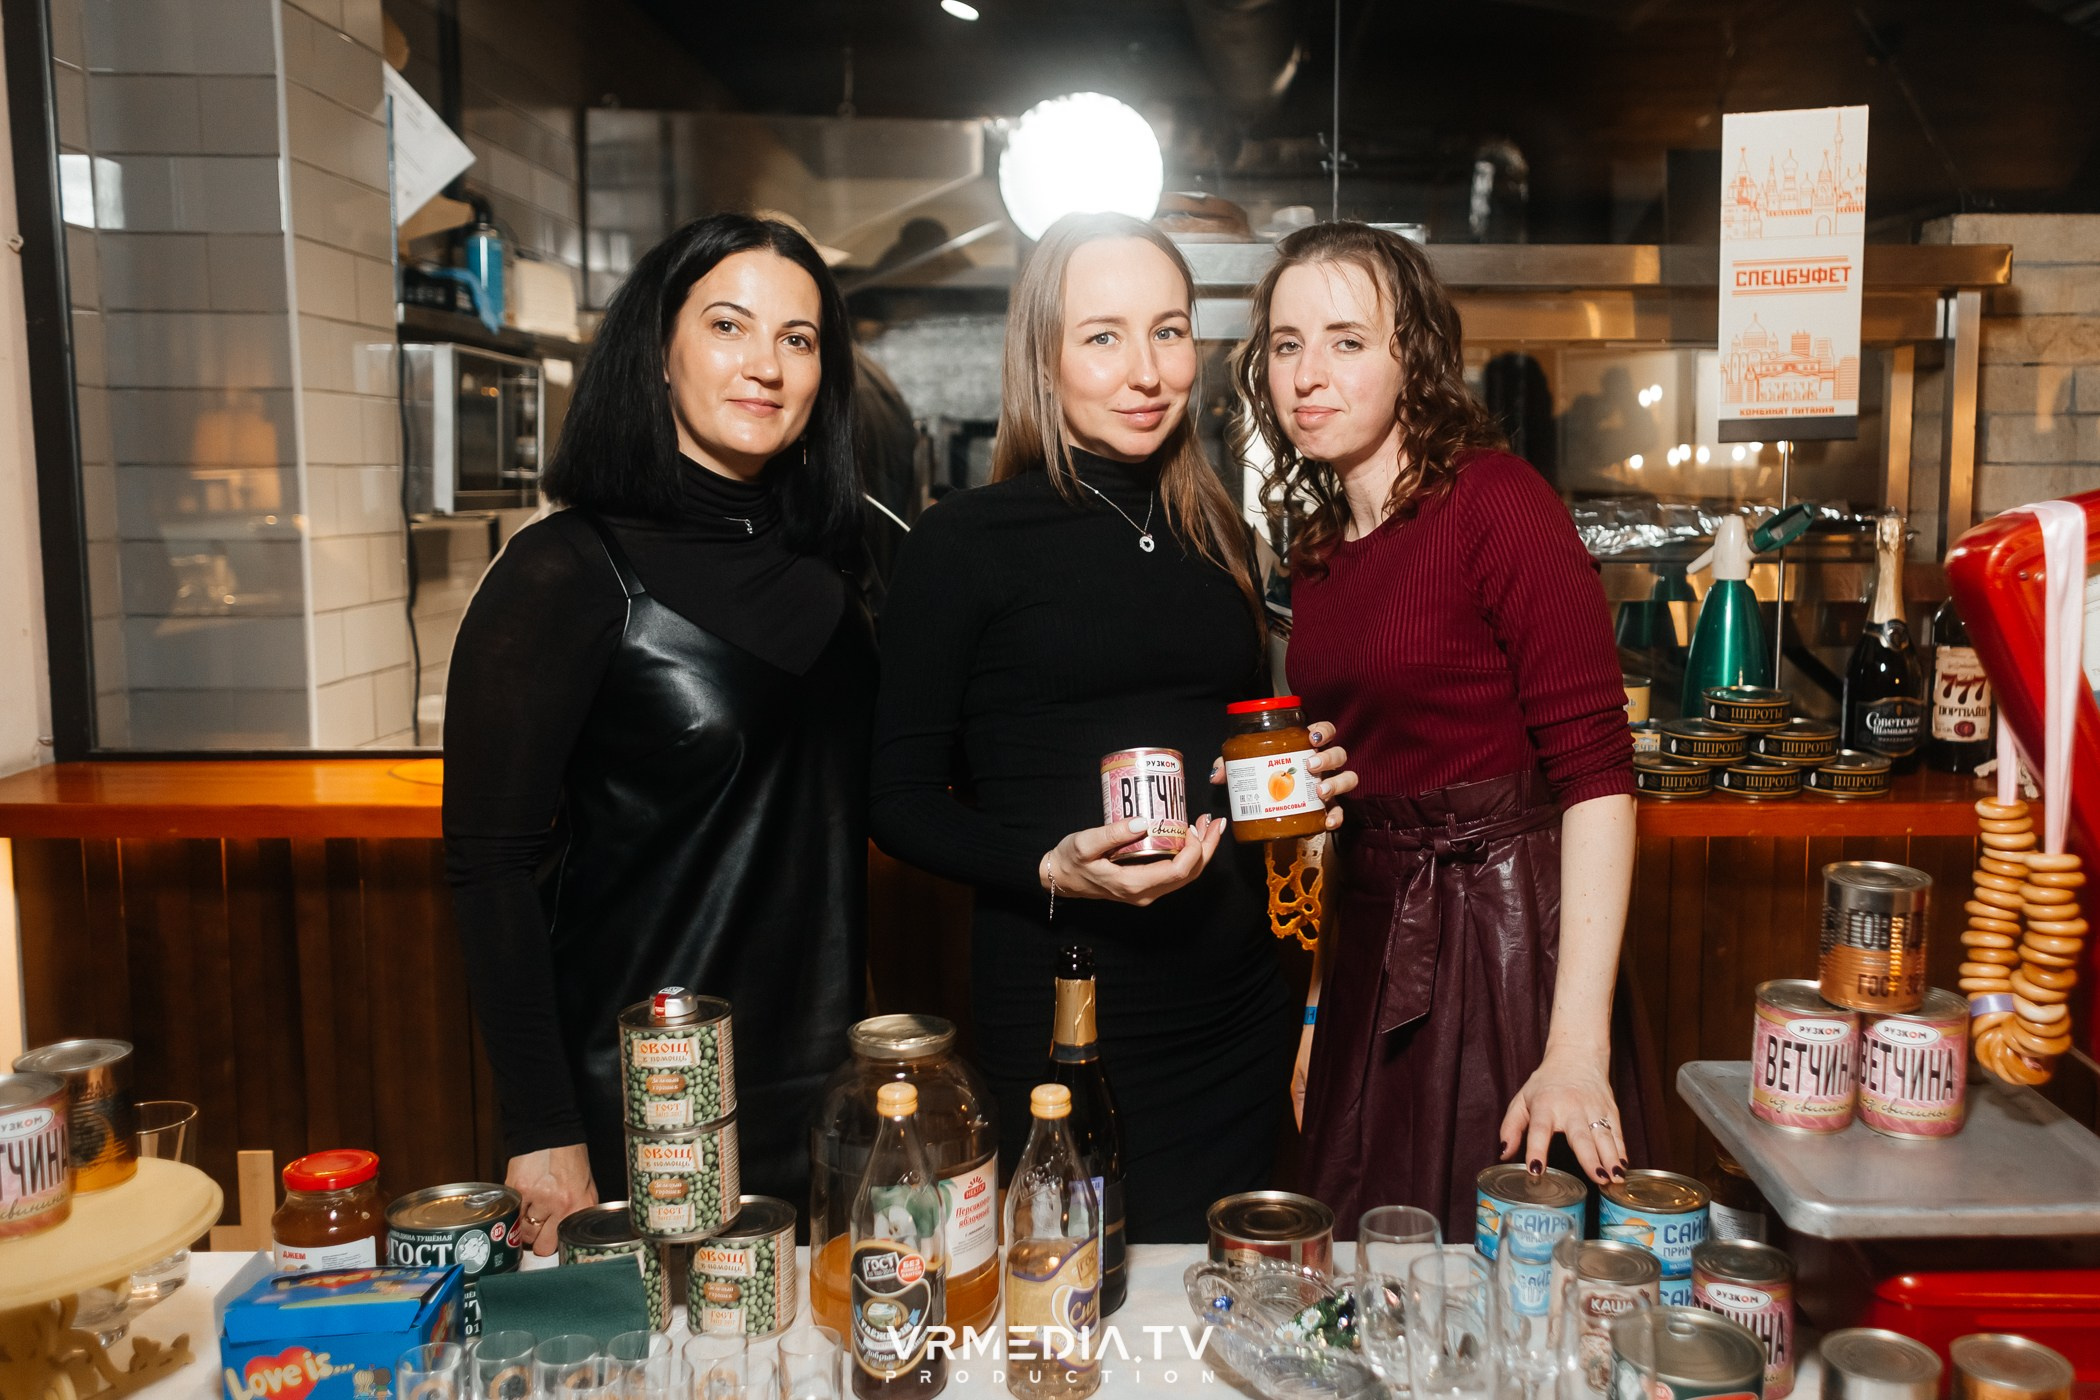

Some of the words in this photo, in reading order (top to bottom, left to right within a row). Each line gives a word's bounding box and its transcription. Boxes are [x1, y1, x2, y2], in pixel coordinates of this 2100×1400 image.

[1735, 266, 1851, 287] СПЕЦБУФЕТ
[1740, 408, 1787, 416] КОМБИНАТ
[1792, 406, 1834, 415] ПИТАНИЯ
[1941, 673, 1988, 704] 777
[1731, 707, 1782, 719] ШПРОТЫ
[1938, 705, 1987, 717] ПОРТВАЙН
[1693, 742, 1743, 754] ШПРОТЫ
[1782, 742, 1832, 753] ШПРОТЫ
[1146, 760, 1176, 768] РУЗКОМ
[1267, 758, 1292, 768] ДЖЕМ
[1661, 776, 1709, 788] ШПРОТЫ
[1746, 776, 1797, 788] ШПРОТЫ
[1833, 776, 1885, 788] ШПРОТЫ
[1121, 775, 1185, 822] ВЕТЧИН
[1264, 801, 1307, 813] АБРИКОСОВЫЙ
[1152, 819, 1187, 834] свинин
[1799, 1026, 1841, 1035] РУЗКОМ
[1884, 1026, 1927, 1040] РУЗКОМ
[640, 1043, 689, 1055] ОВОЩ
[1859, 1034, 1954, 1102] ВЕТЧИНА
[655, 1103, 680, 1111] ГОСТ
[1769, 1096, 1785, 1113] из
[0, 1116, 43, 1132] УЗКОМ
[644, 1148, 692, 1161] ОВОЩ
[658, 1207, 681, 1215] ГОСТ
[416, 1234, 453, 1242] ТУШЁНАЯ
[282, 1250, 306, 1260] ДЖЕМ
[390, 1237, 453, 1268] ГОСТ
[1663, 1244, 1694, 1257] ПРИМ
[699, 1249, 745, 1265] ОВОЩ
[866, 1257, 894, 1271] ГОСТ
[903, 1259, 920, 1268] БЕЗ
[1716, 1288, 1759, 1304] РУЗКОМ
[1590, 1299, 1635, 1314] КАША
[711, 1311, 734, 1320] ГОСТ
[225, 1362, 302, 1400] Love
[303, 1350, 355, 1380] is...
